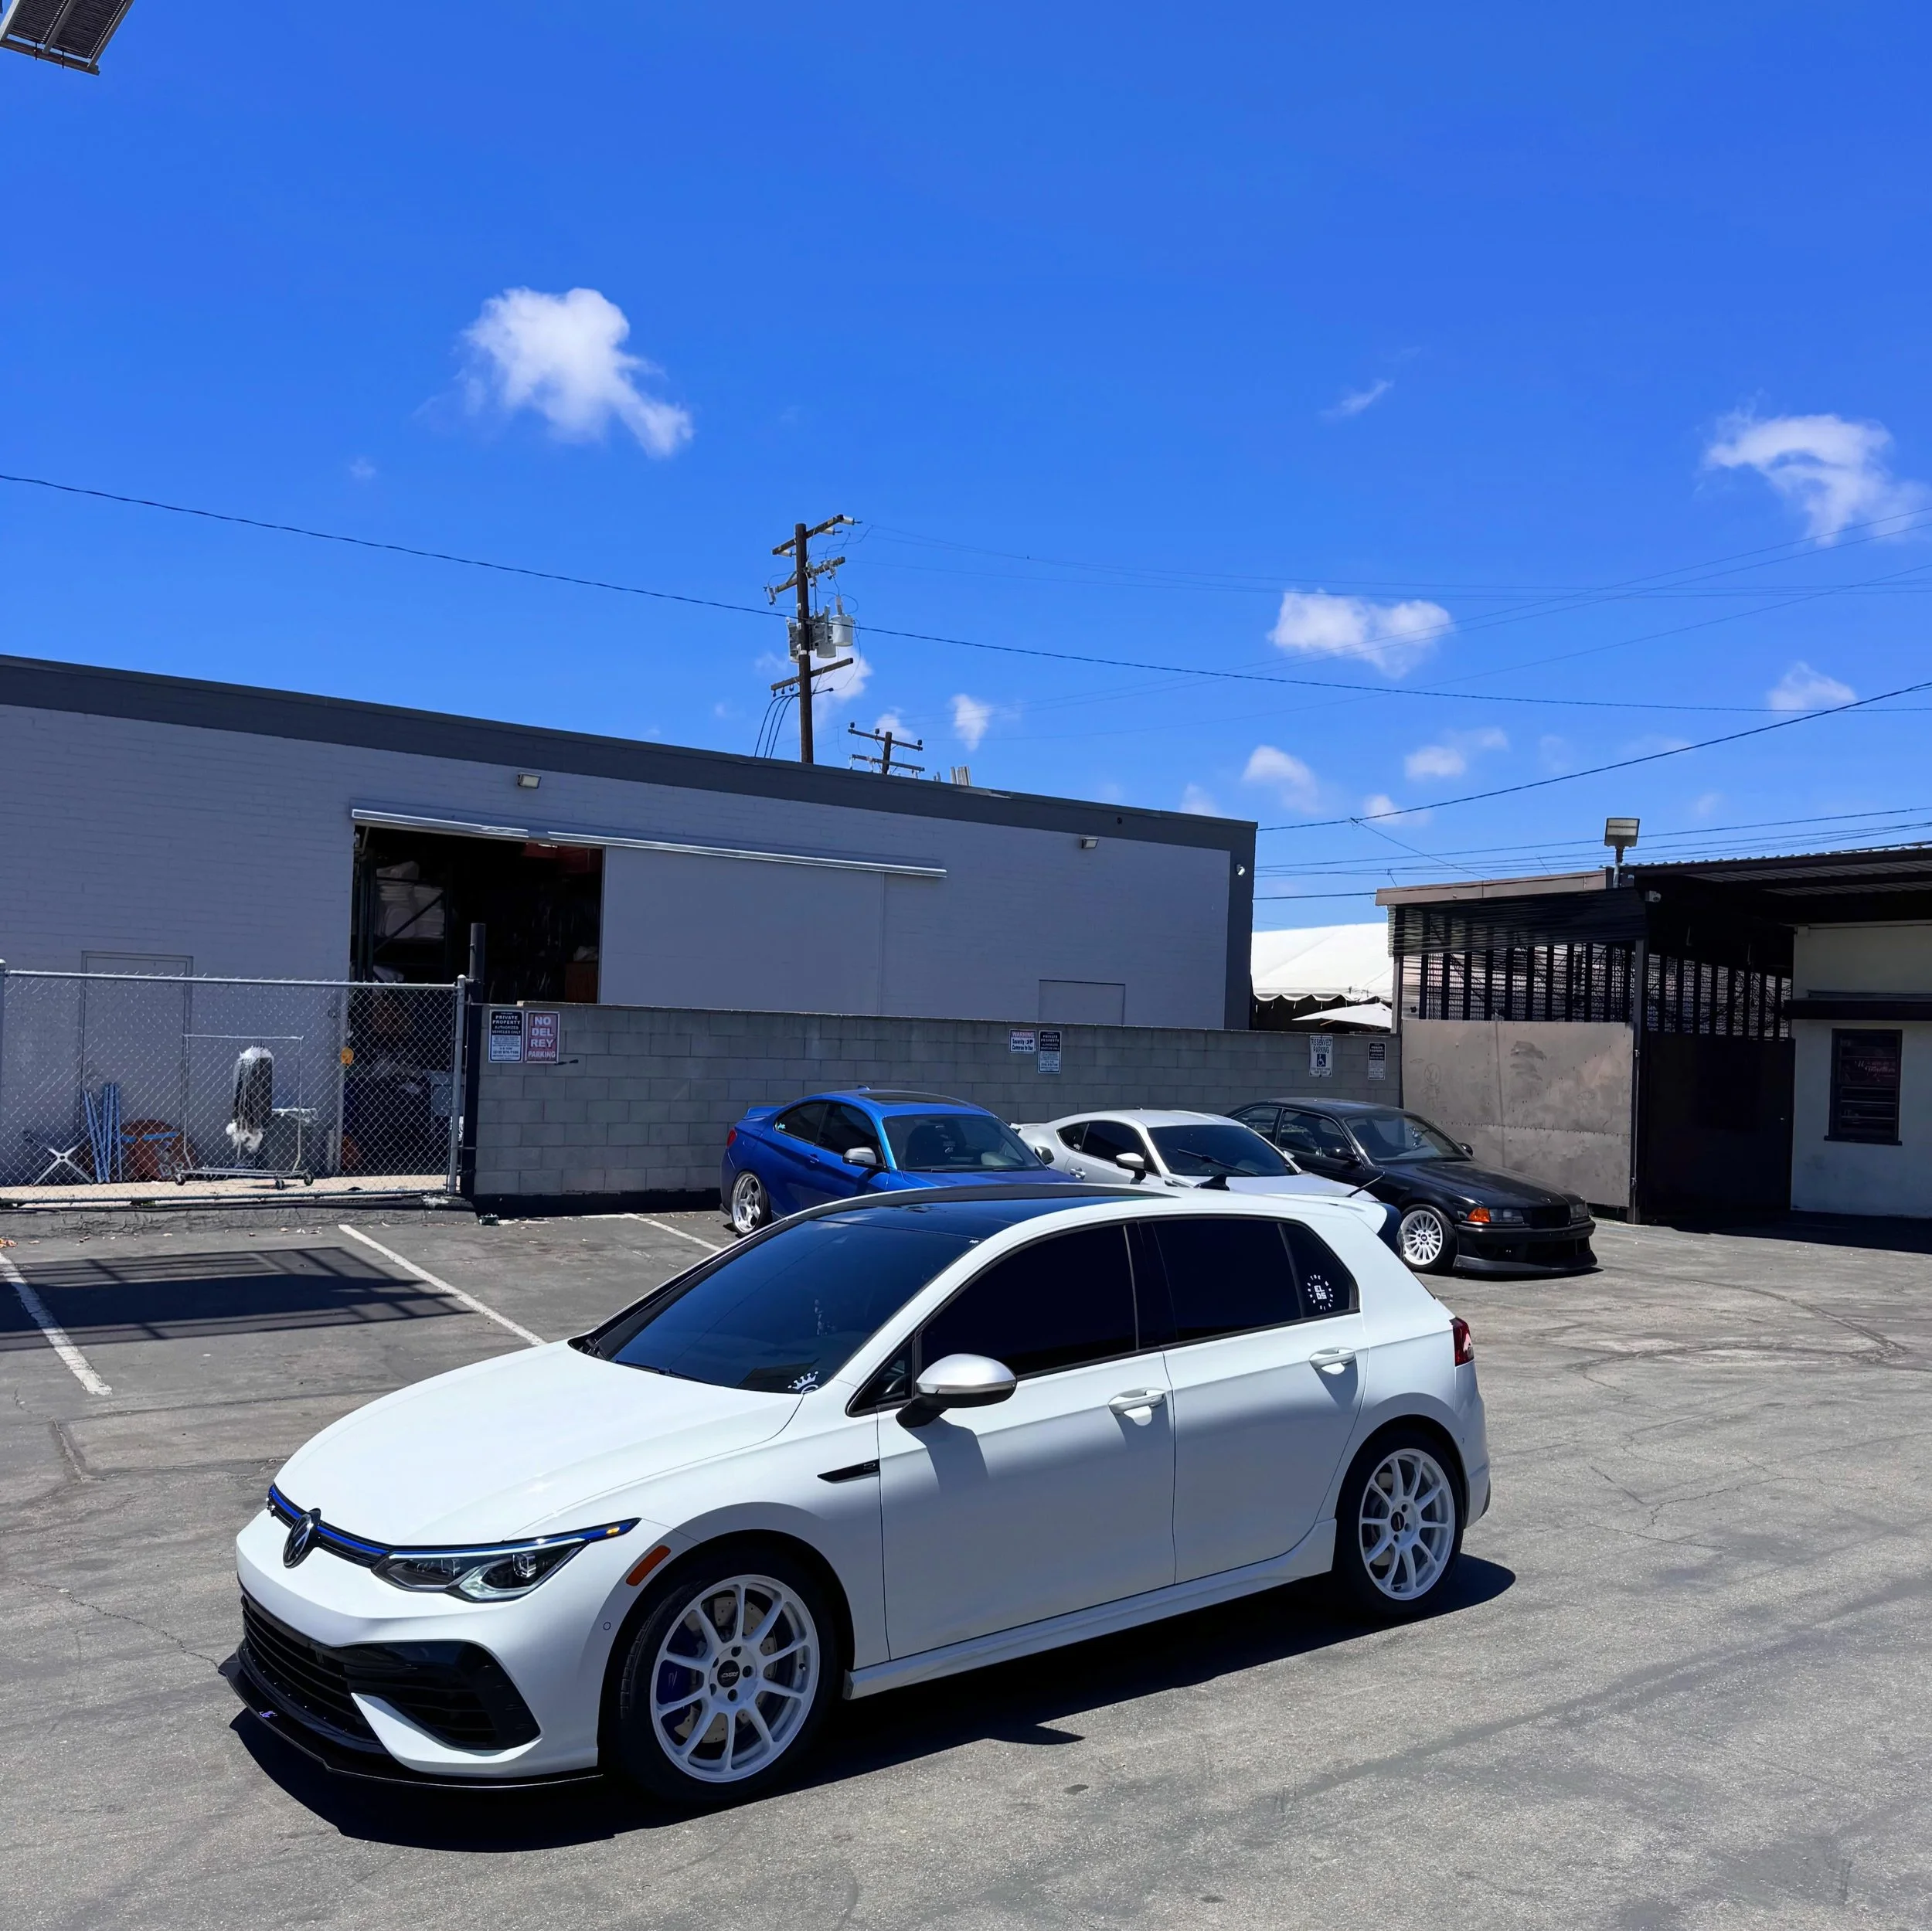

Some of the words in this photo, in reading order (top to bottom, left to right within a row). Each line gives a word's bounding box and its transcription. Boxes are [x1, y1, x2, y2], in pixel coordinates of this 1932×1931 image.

[534, 1016, 552, 1025] NO
[531, 1027, 553, 1036] DEL
[530, 1039, 554, 1048] REY
